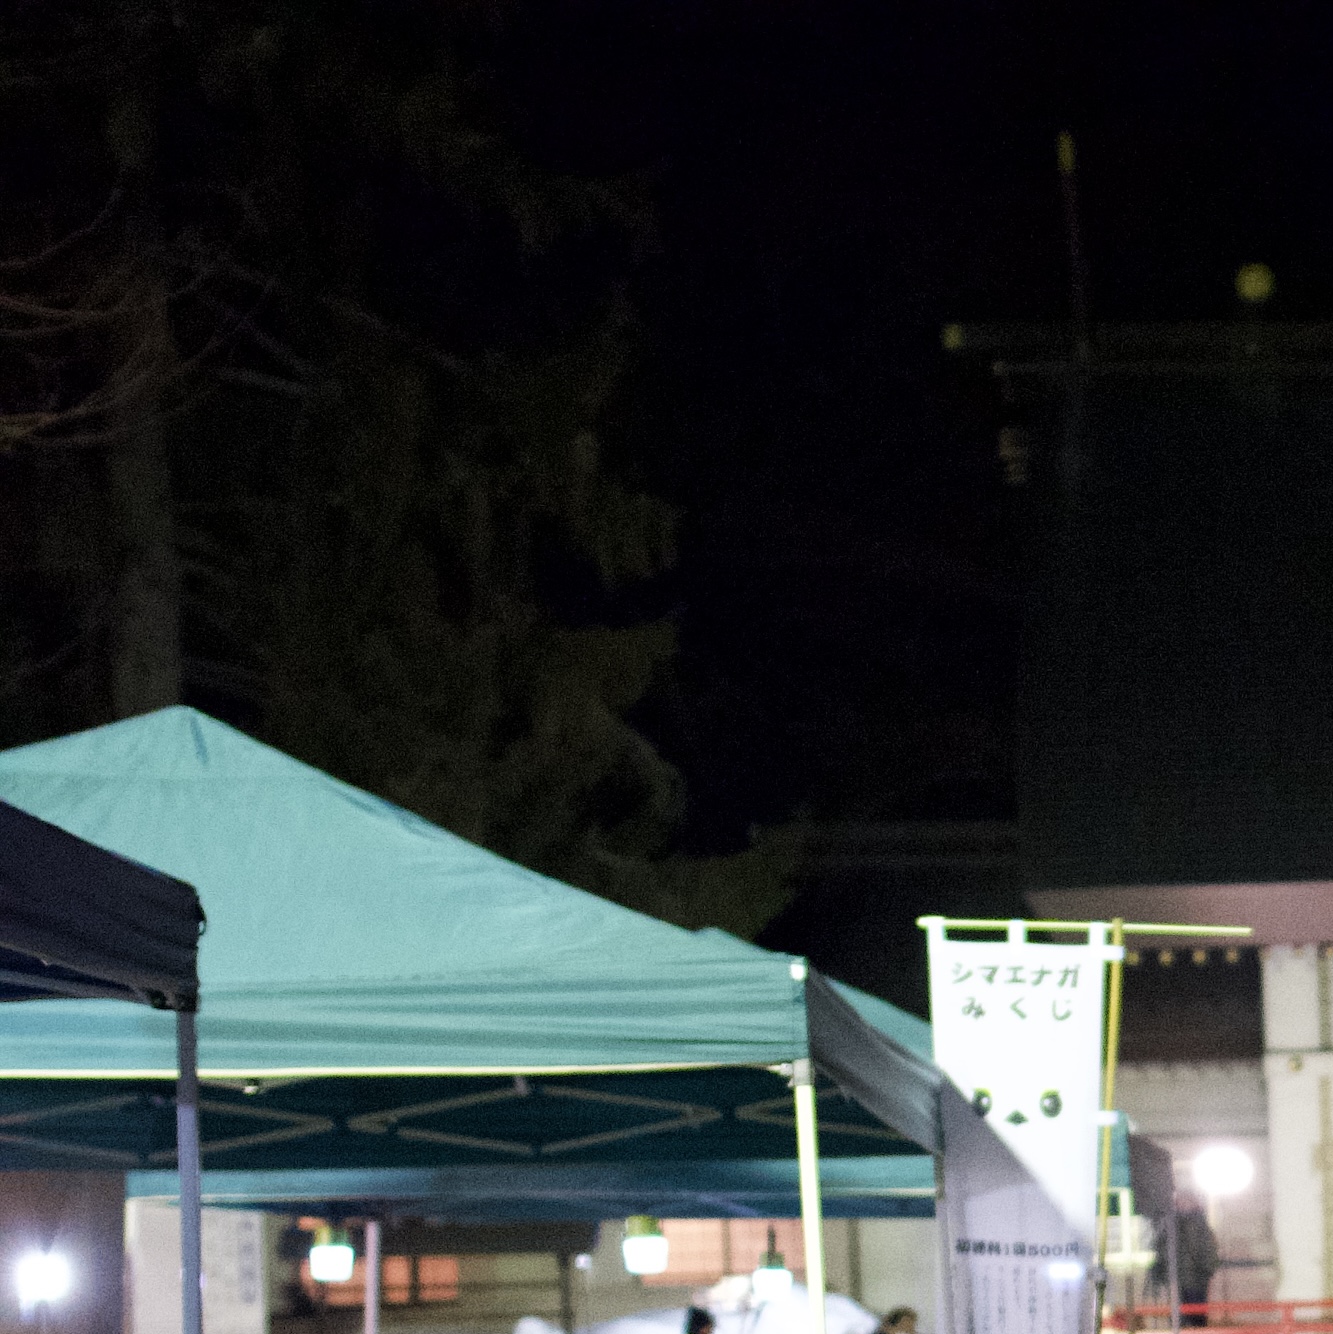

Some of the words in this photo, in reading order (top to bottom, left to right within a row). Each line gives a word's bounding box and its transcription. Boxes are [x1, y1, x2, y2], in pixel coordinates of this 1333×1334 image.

[952, 962, 1080, 988] シマエナガ
[961, 997, 1072, 1021] みくじ
